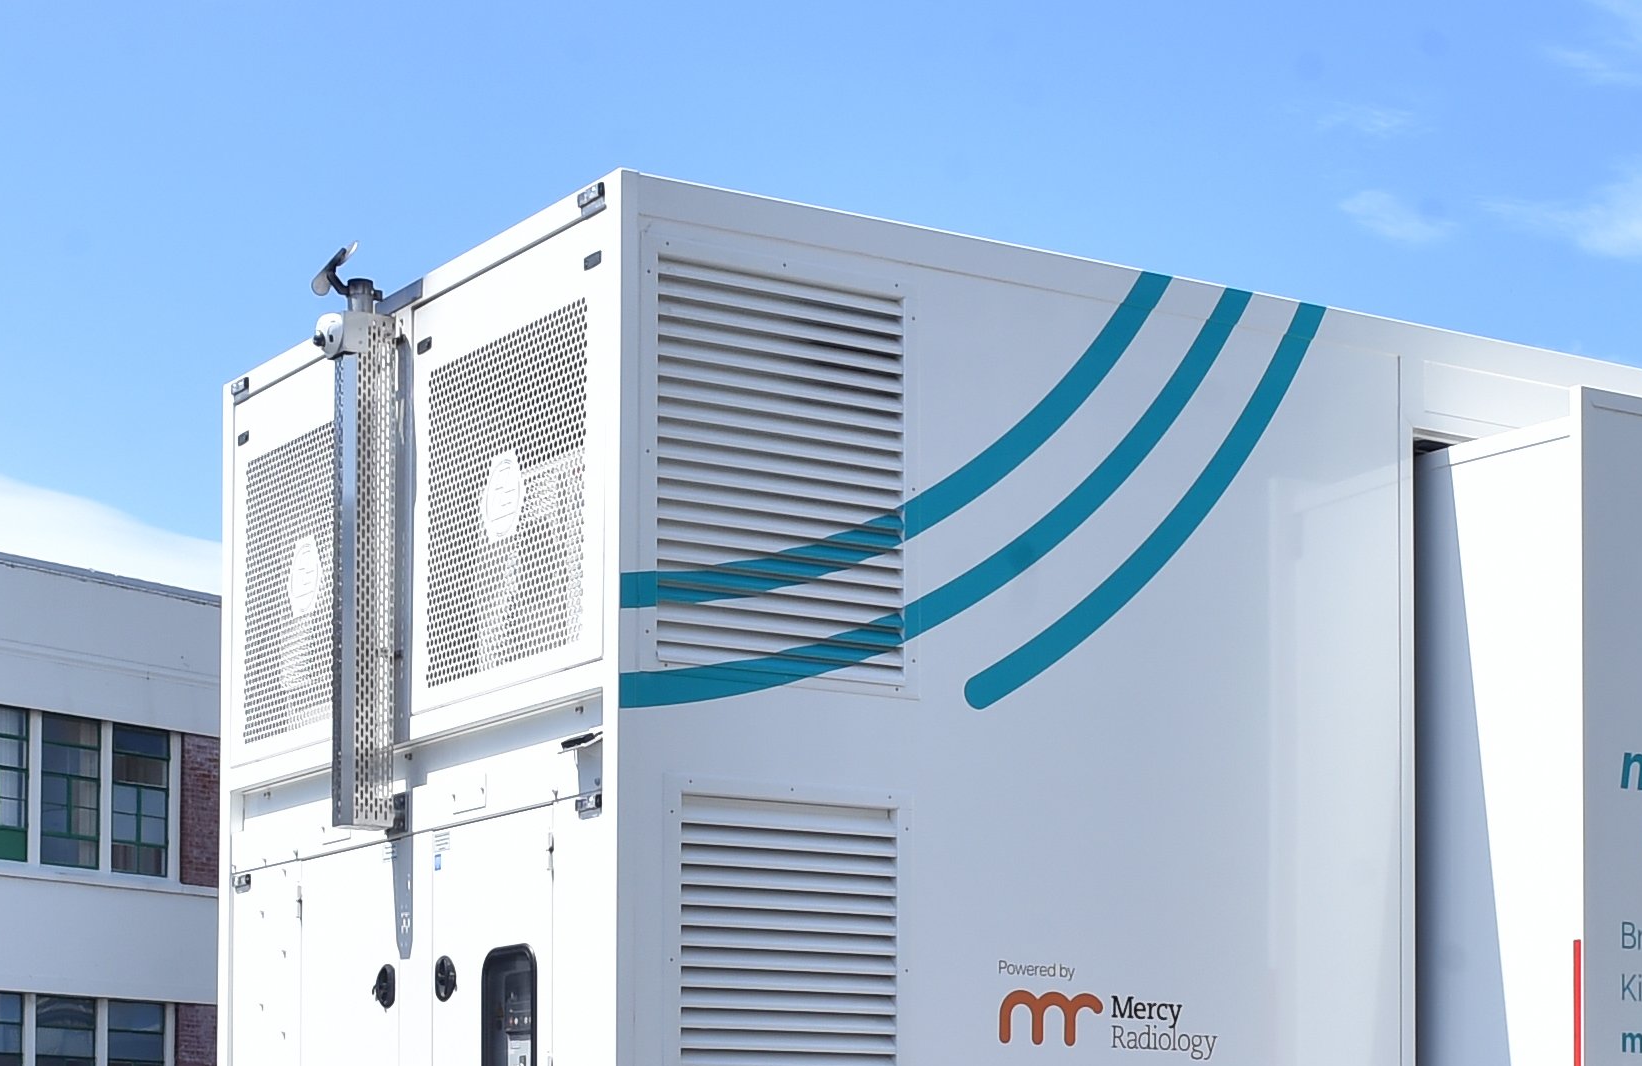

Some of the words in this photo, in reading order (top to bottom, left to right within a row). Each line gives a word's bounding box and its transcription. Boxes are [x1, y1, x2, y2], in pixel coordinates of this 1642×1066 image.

[998, 959, 1056, 978] Powered
[1059, 963, 1075, 981] by
[1111, 995, 1183, 1028] Mercy
[1111, 1024, 1217, 1060] Radiology
